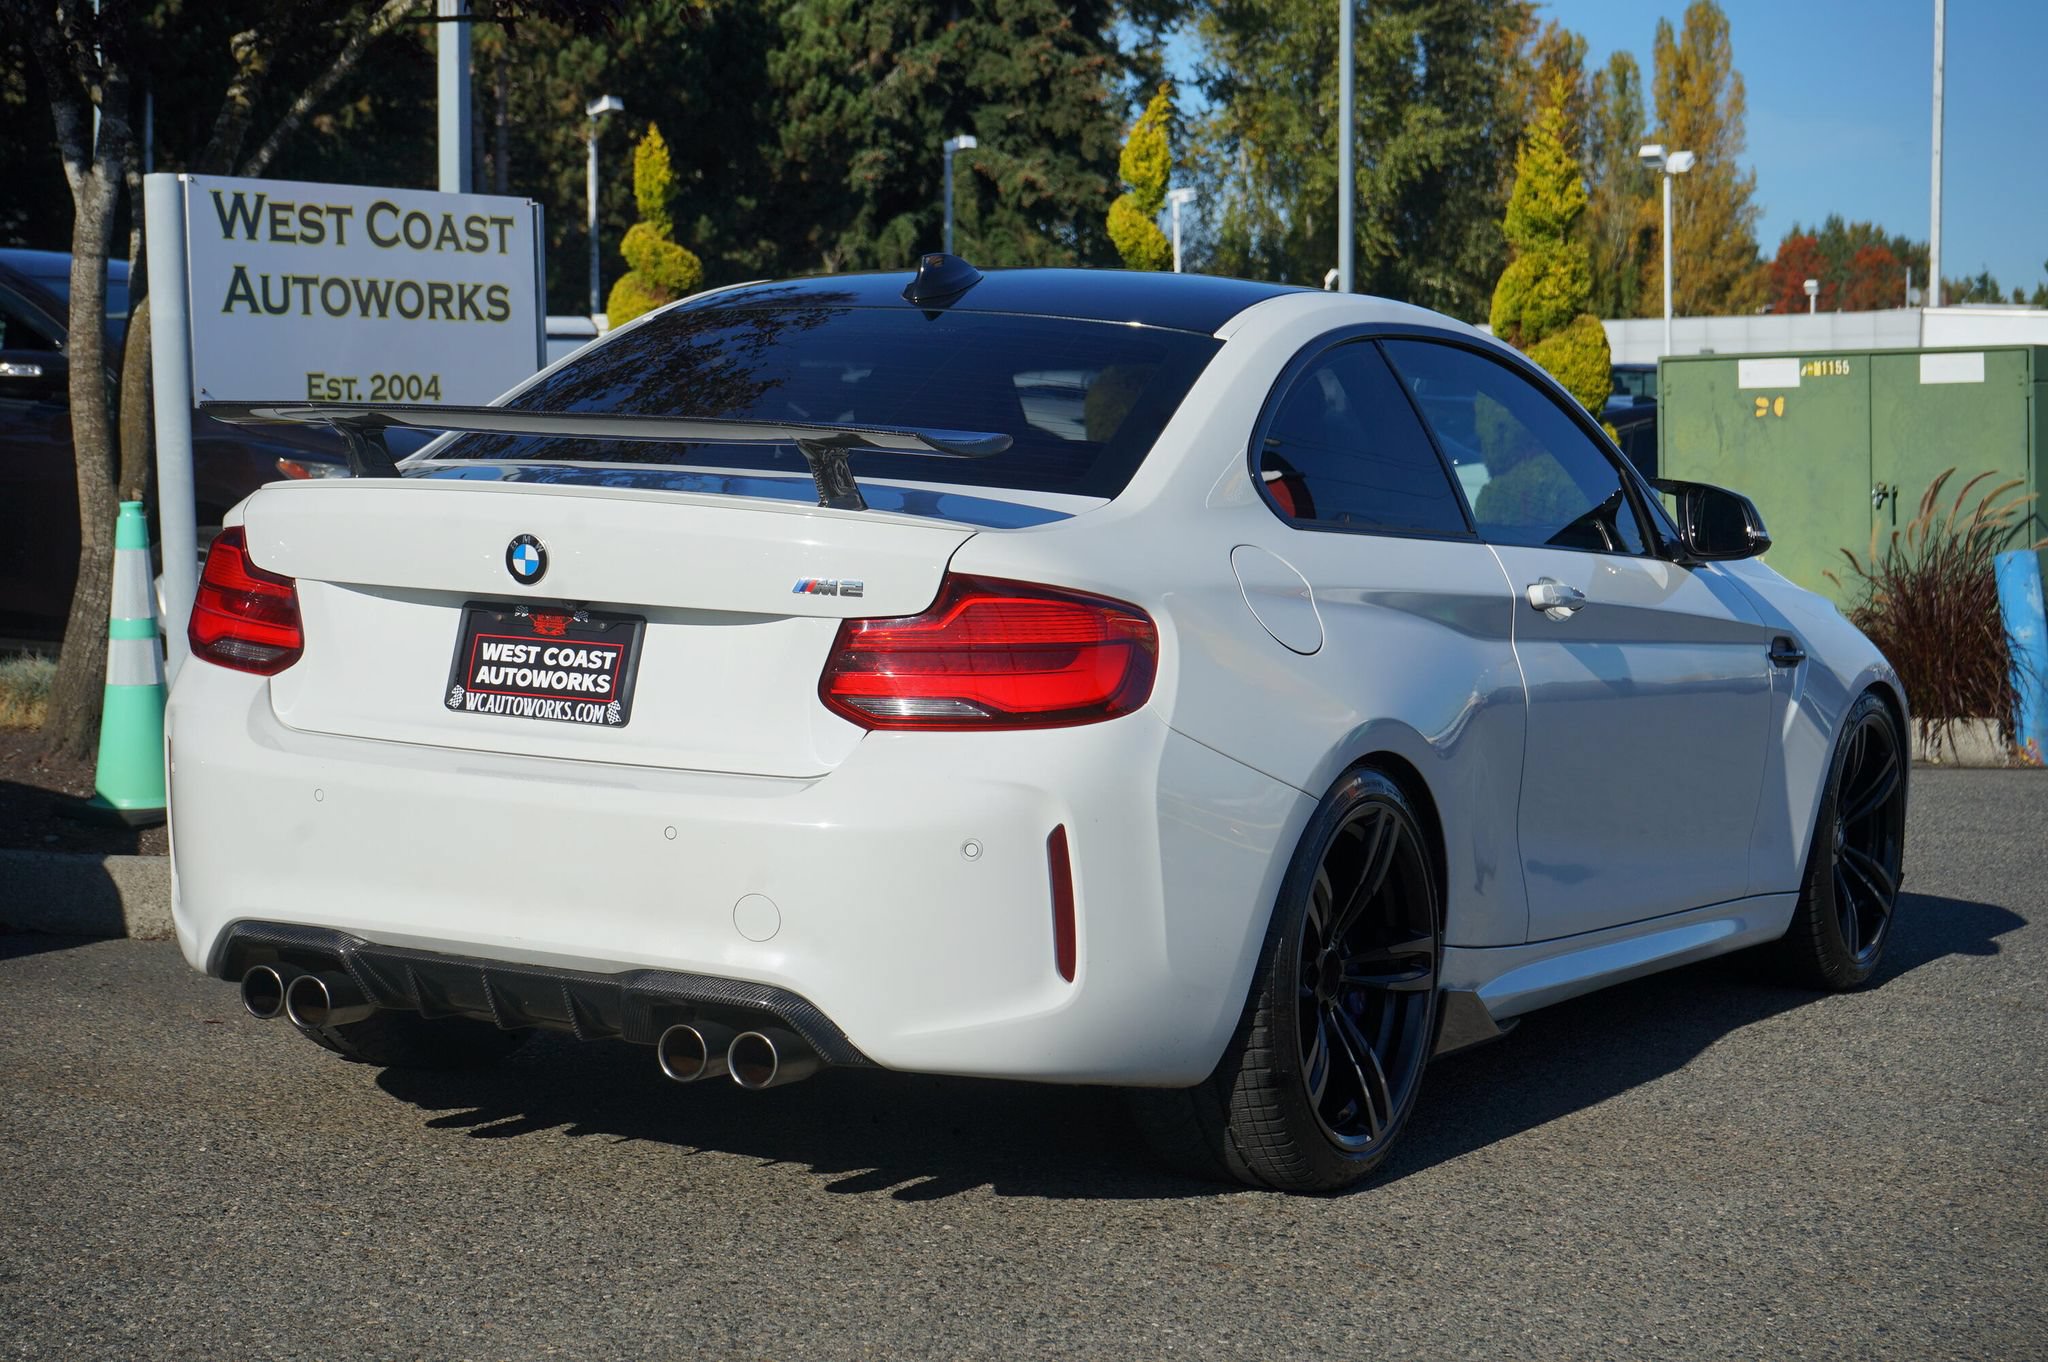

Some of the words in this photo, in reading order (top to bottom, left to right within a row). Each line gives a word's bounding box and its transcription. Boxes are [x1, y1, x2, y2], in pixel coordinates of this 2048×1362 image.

[209, 190, 353, 245] WEST
[366, 201, 515, 254] COAST
[221, 264, 511, 322] AUTOWORKS
[370, 374, 441, 401] 2004
[803, 578, 863, 597] M2
[482, 643, 541, 664] WEST
[543, 647, 617, 670] COAST
[475, 665, 611, 693] AUTOWORKS
[465, 692, 606, 724] WCAUTOWORKS.COM
